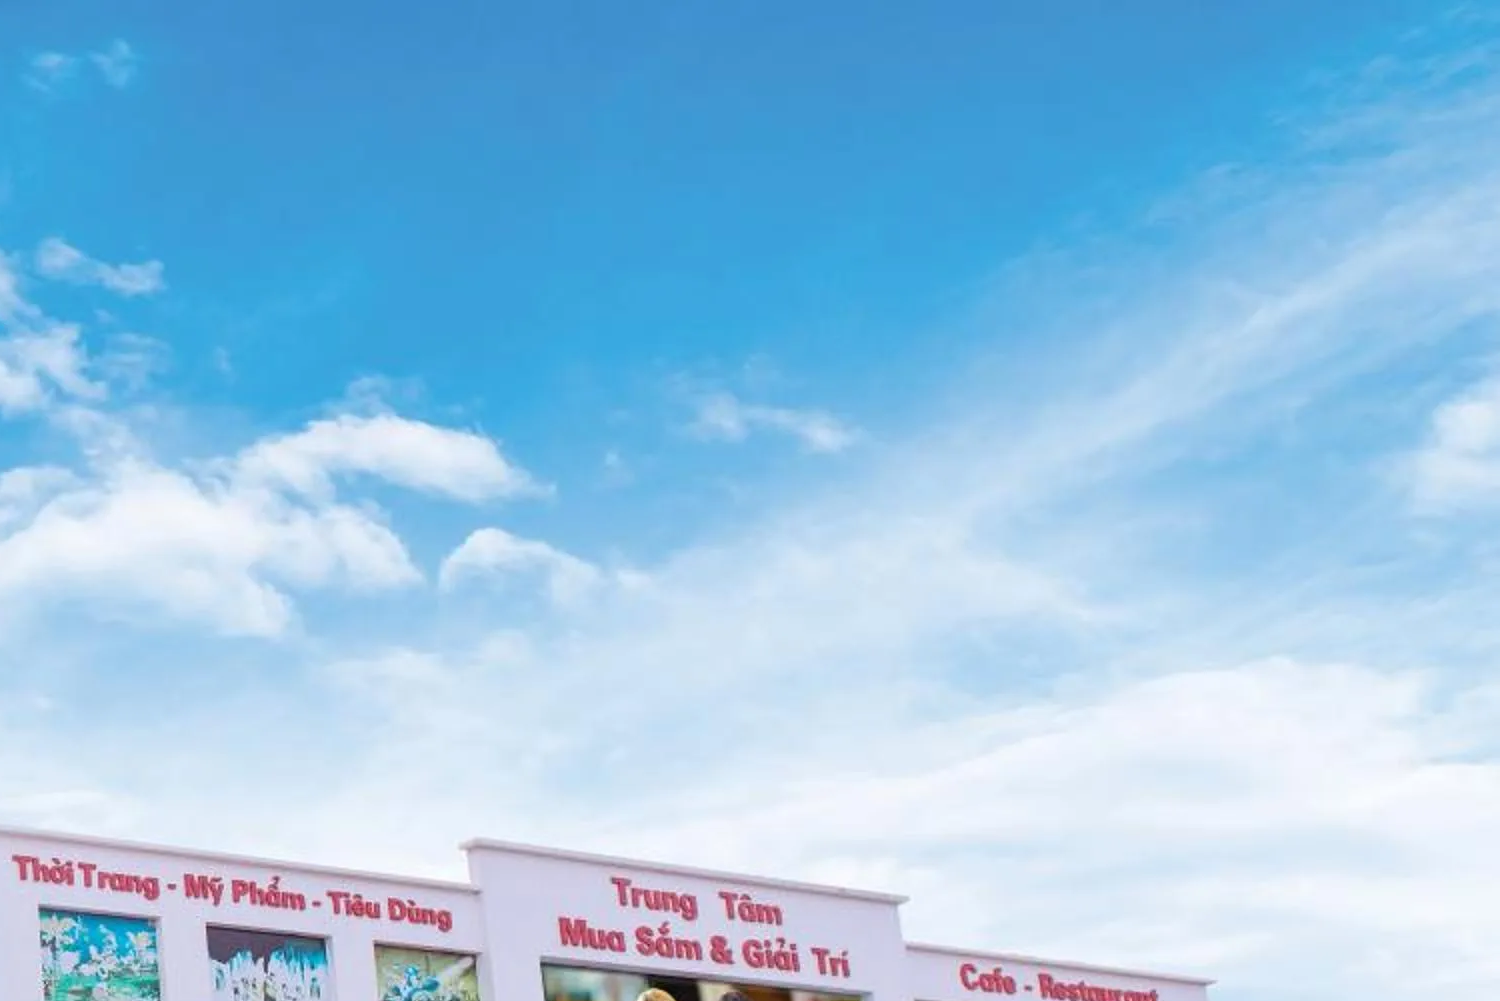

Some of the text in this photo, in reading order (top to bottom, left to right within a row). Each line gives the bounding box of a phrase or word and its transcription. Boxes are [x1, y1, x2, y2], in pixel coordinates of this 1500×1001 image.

[12, 855, 75, 887] Thời
[77, 862, 161, 900] Trang
[183, 873, 224, 906] Mỹ
[231, 877, 306, 911] Phẩm
[325, 890, 382, 920] Tiêu
[387, 897, 453, 932] Dùng
[611, 876, 784, 926] Trung Tâm
[558, 916, 850, 977] Mua Sắm & Giải Trí
